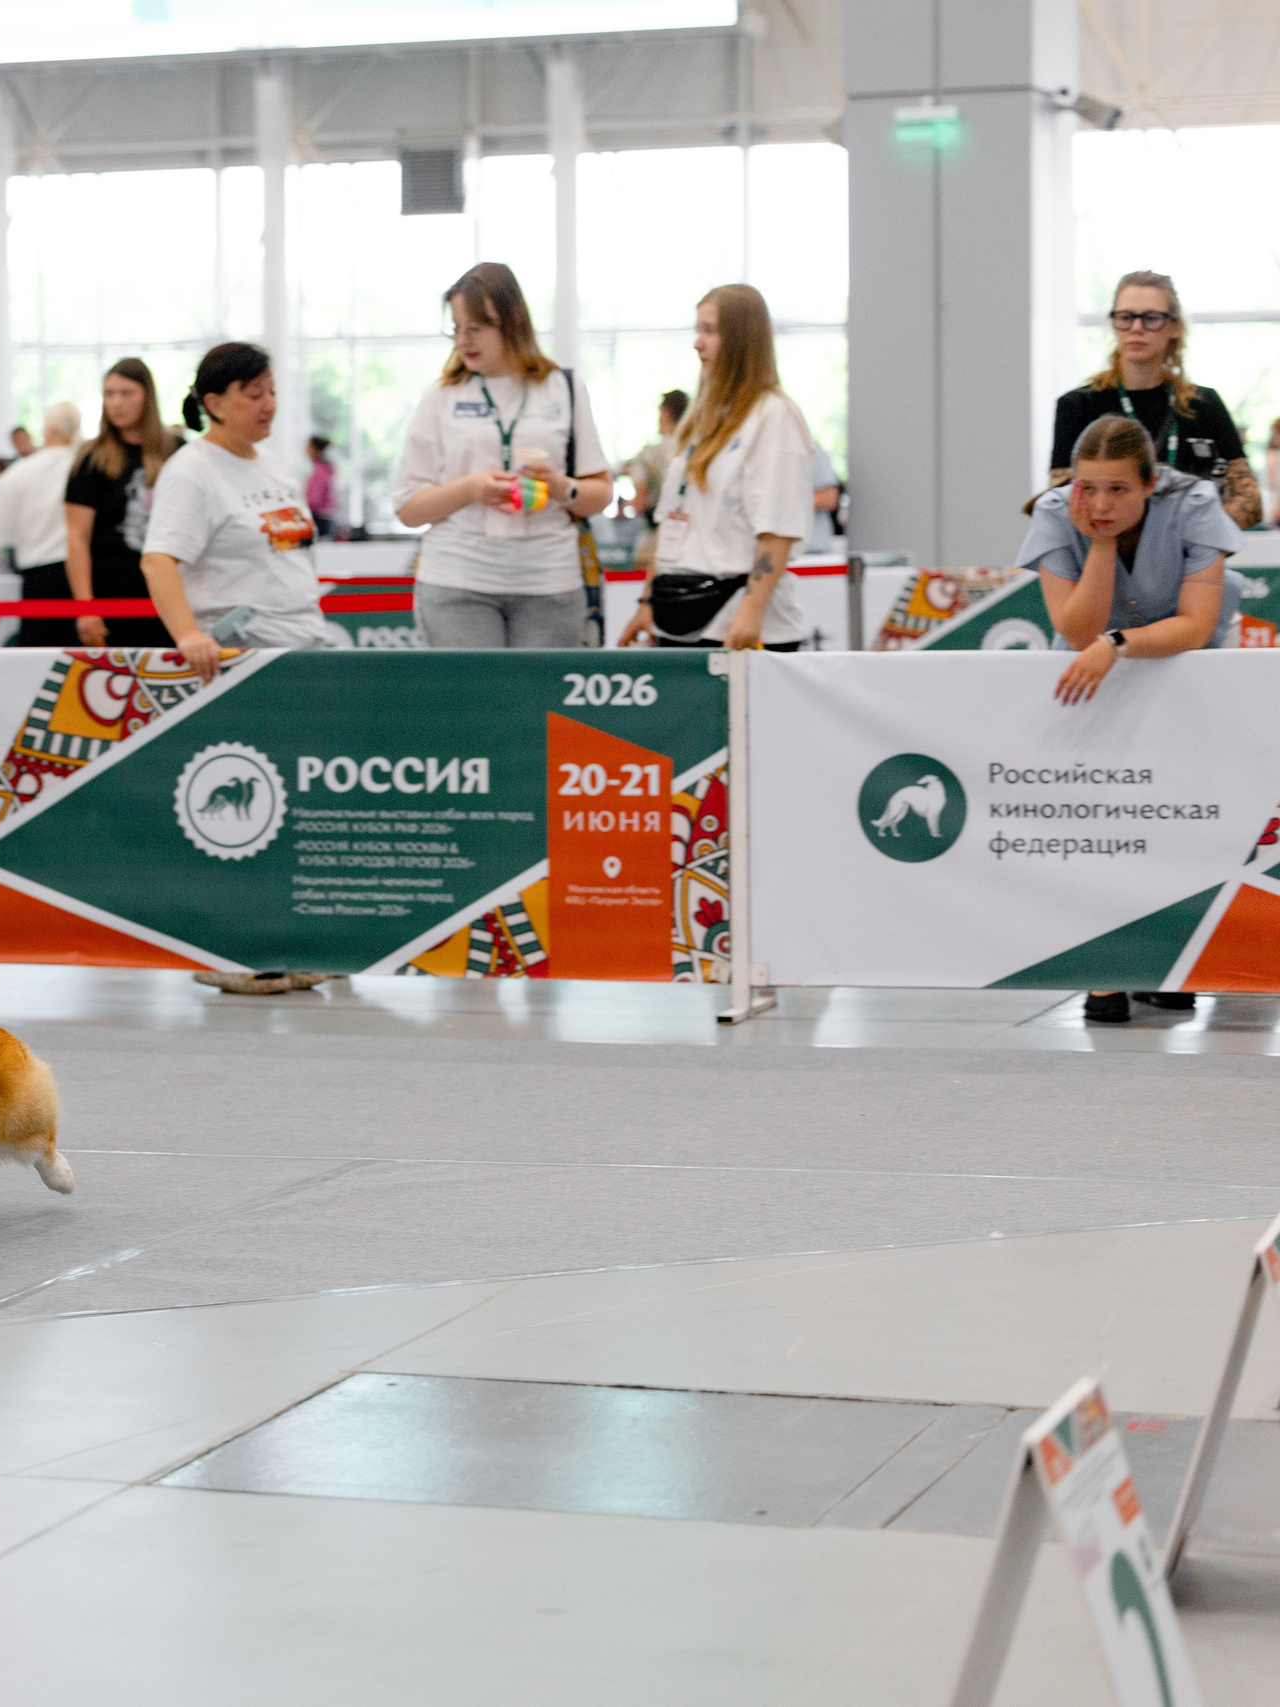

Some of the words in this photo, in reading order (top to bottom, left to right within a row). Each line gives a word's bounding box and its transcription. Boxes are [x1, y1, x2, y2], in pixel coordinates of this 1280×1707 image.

[562, 673, 658, 706] 2026
[297, 756, 490, 794] РОССИЯ
[558, 763, 660, 796] 20-21
[988, 762, 1153, 786] Российская
[563, 810, 660, 832] ИЮНЯ
[989, 799, 1220, 822] кинологическая
[989, 831, 1148, 860] федерация
